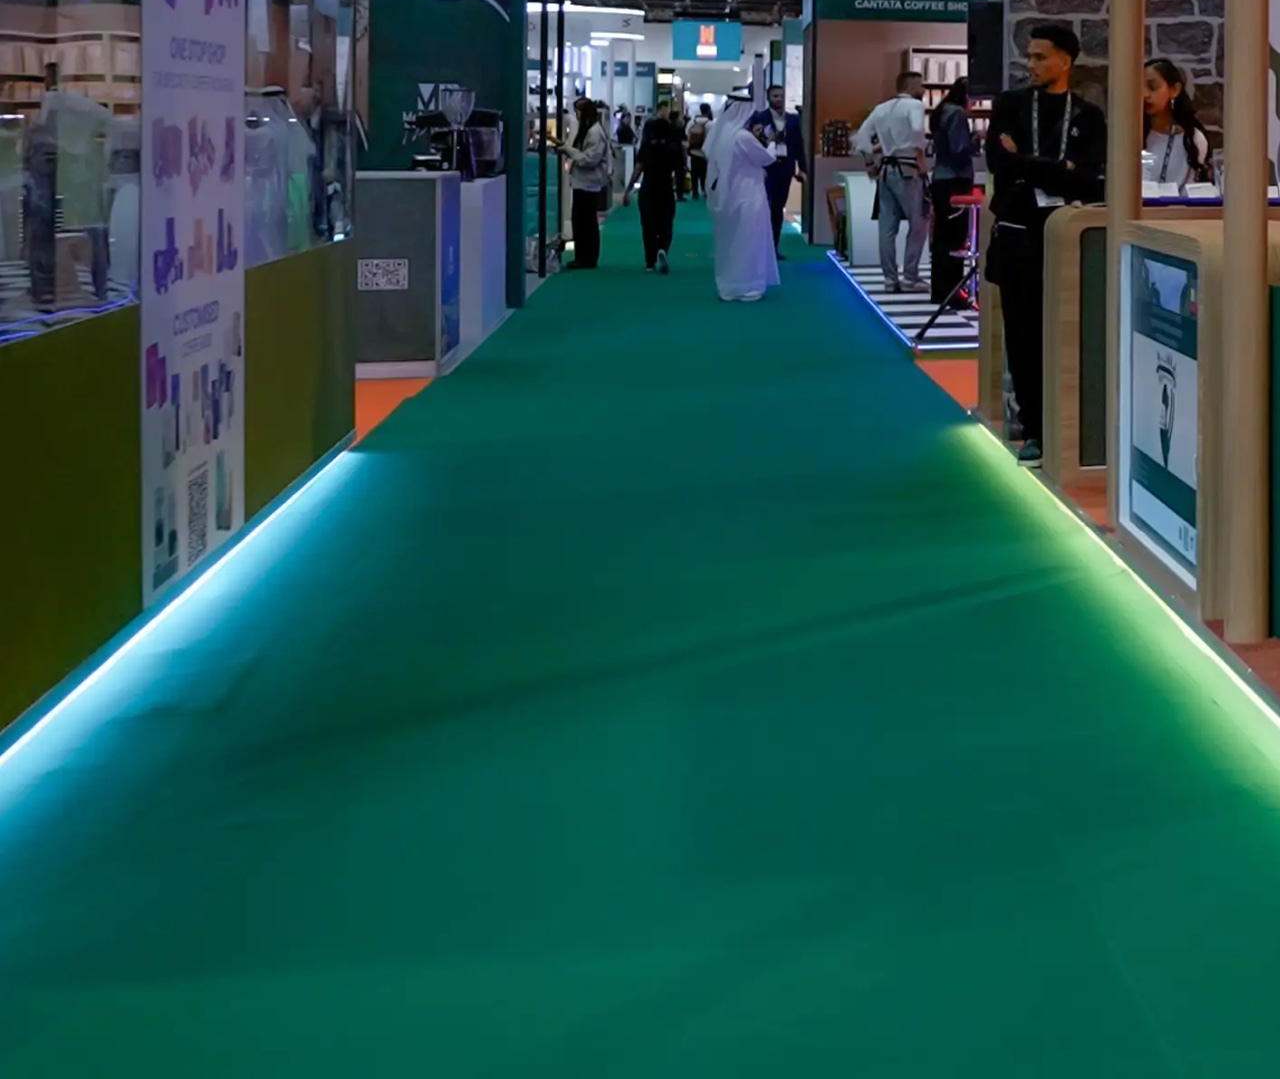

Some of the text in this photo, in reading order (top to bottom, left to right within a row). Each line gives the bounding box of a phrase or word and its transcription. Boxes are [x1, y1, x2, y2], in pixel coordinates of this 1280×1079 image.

[854, 0, 968, 11] CANTATA COFFEE SHO
